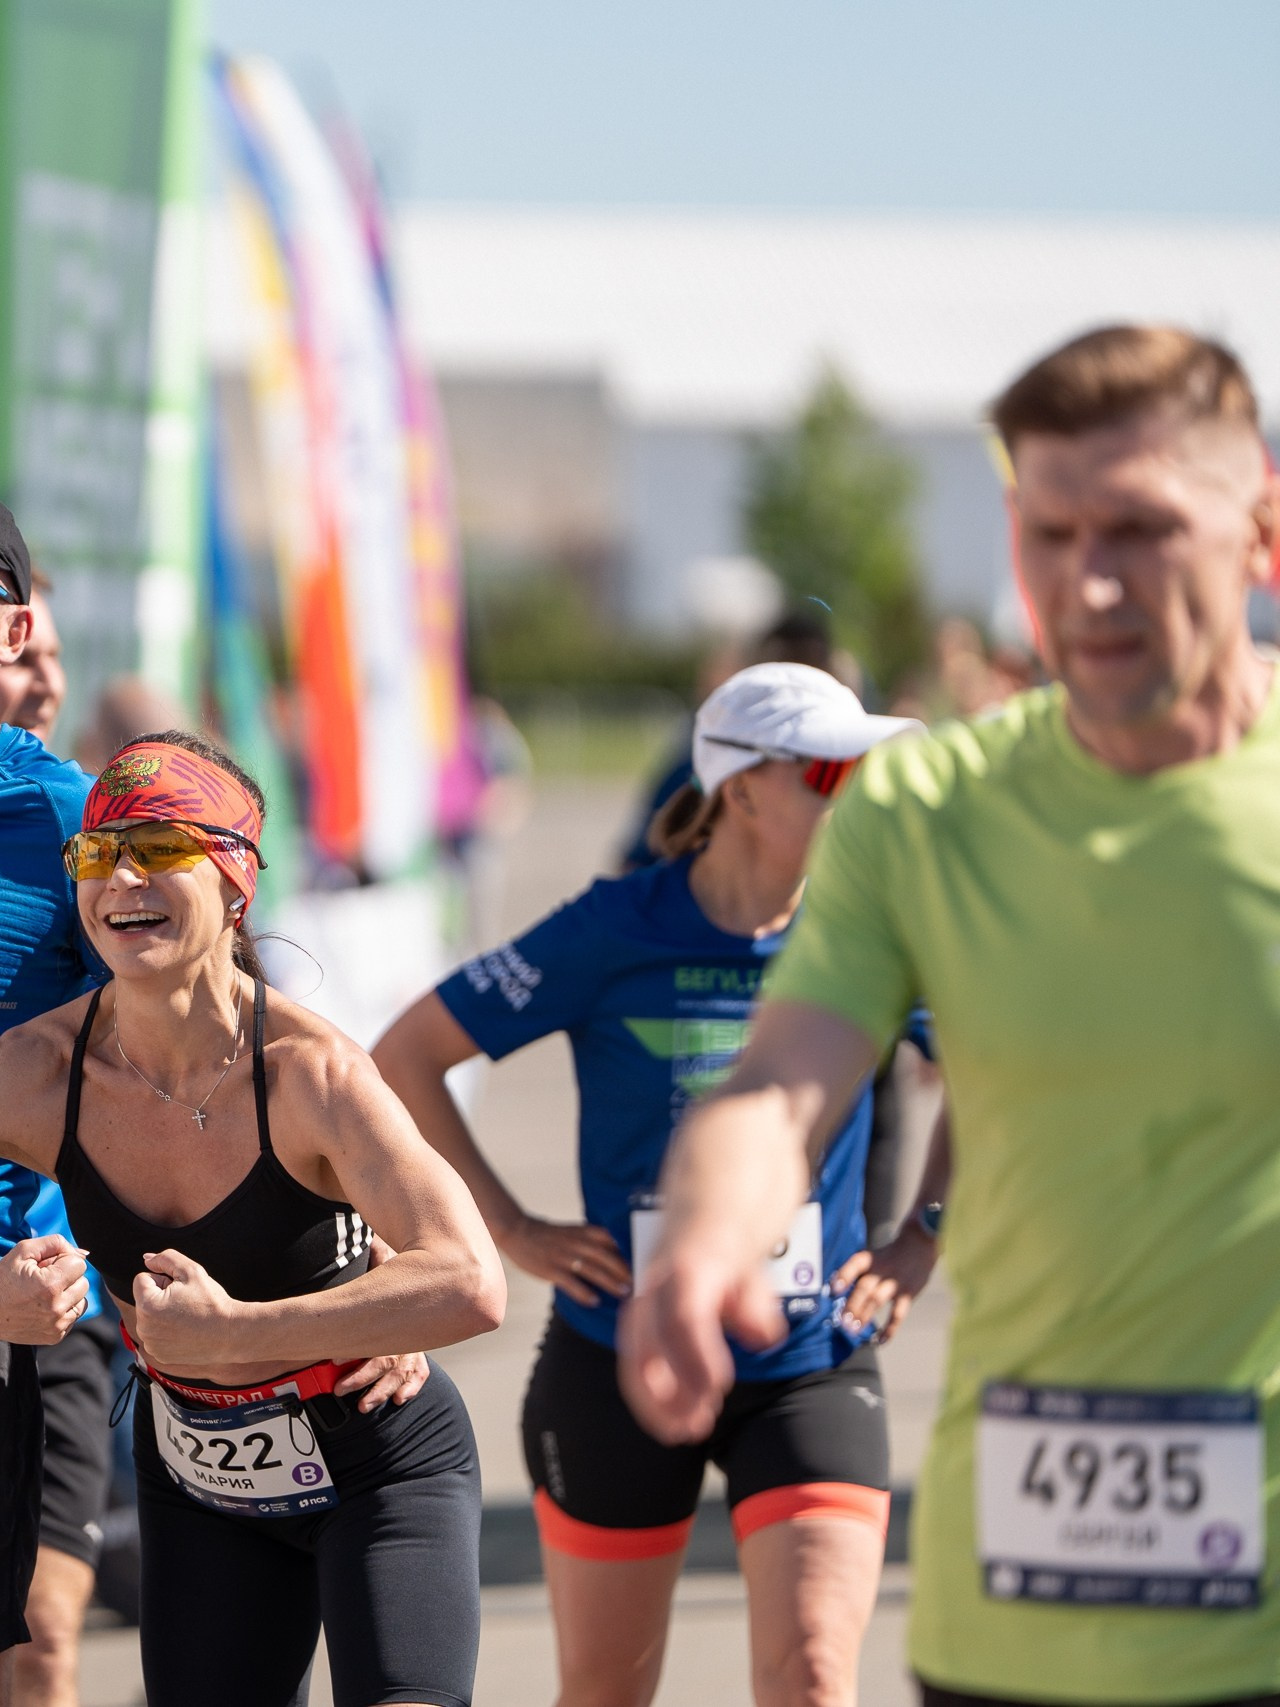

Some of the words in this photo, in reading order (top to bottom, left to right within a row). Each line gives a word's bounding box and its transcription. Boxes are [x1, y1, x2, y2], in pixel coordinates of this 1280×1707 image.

[165, 1415, 283, 1472] 4222
[193, 1468, 255, 1490] МАРИЯ
[1021, 1436, 1204, 1515] 4935
